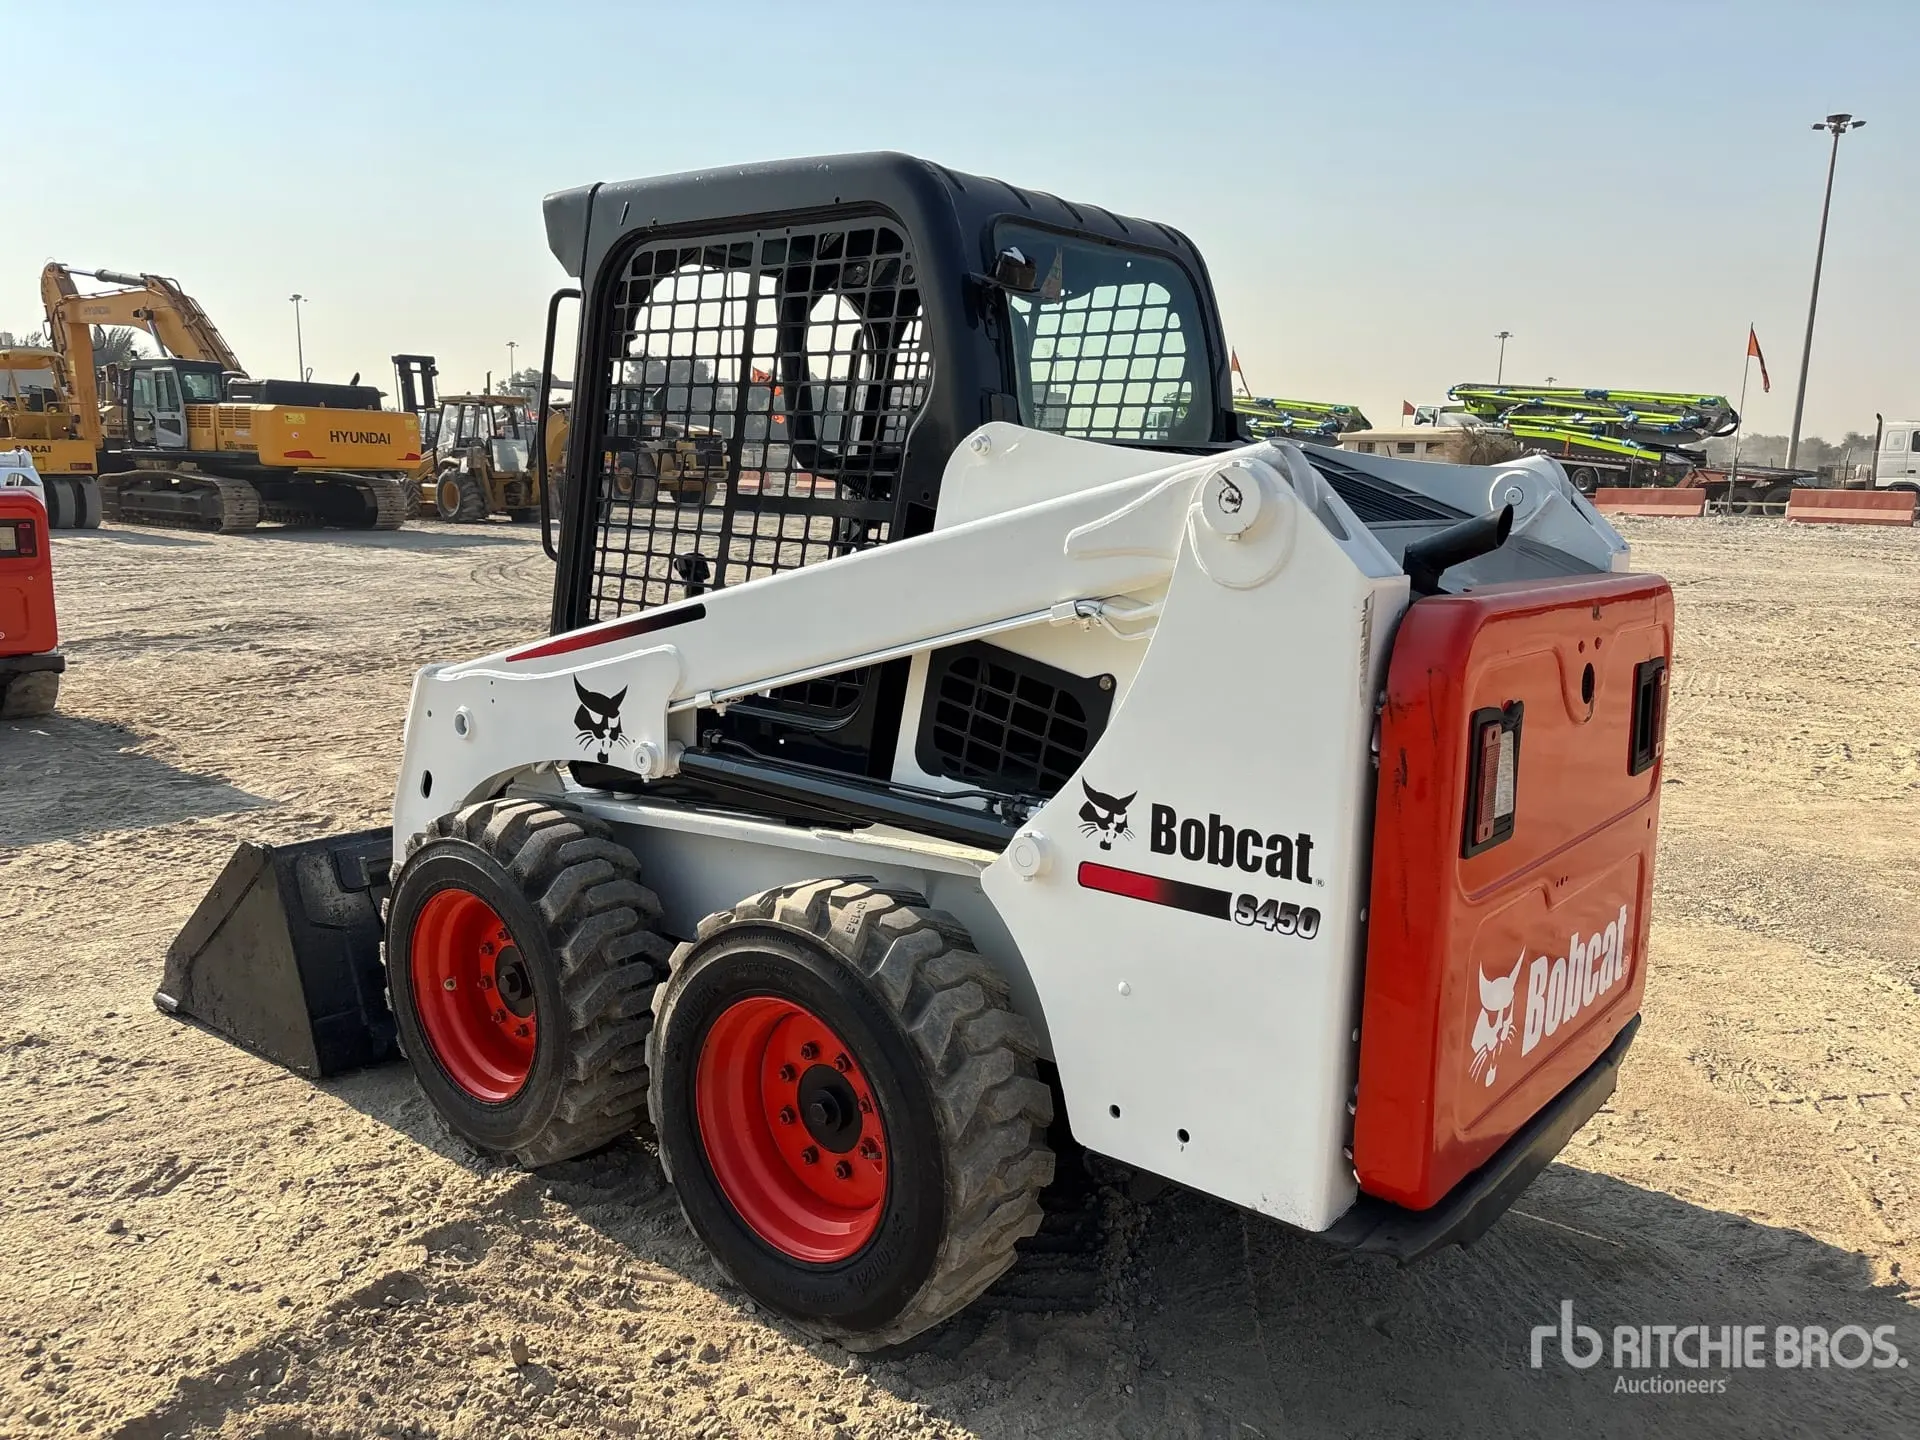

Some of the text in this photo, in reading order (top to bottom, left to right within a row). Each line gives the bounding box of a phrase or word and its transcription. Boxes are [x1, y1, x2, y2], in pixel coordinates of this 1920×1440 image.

[329, 430, 392, 445] HYUNDAI
[1150, 803, 1314, 884] Bobcat
[1235, 894, 1321, 940] S450
[1521, 904, 1627, 1058] Bobcat
